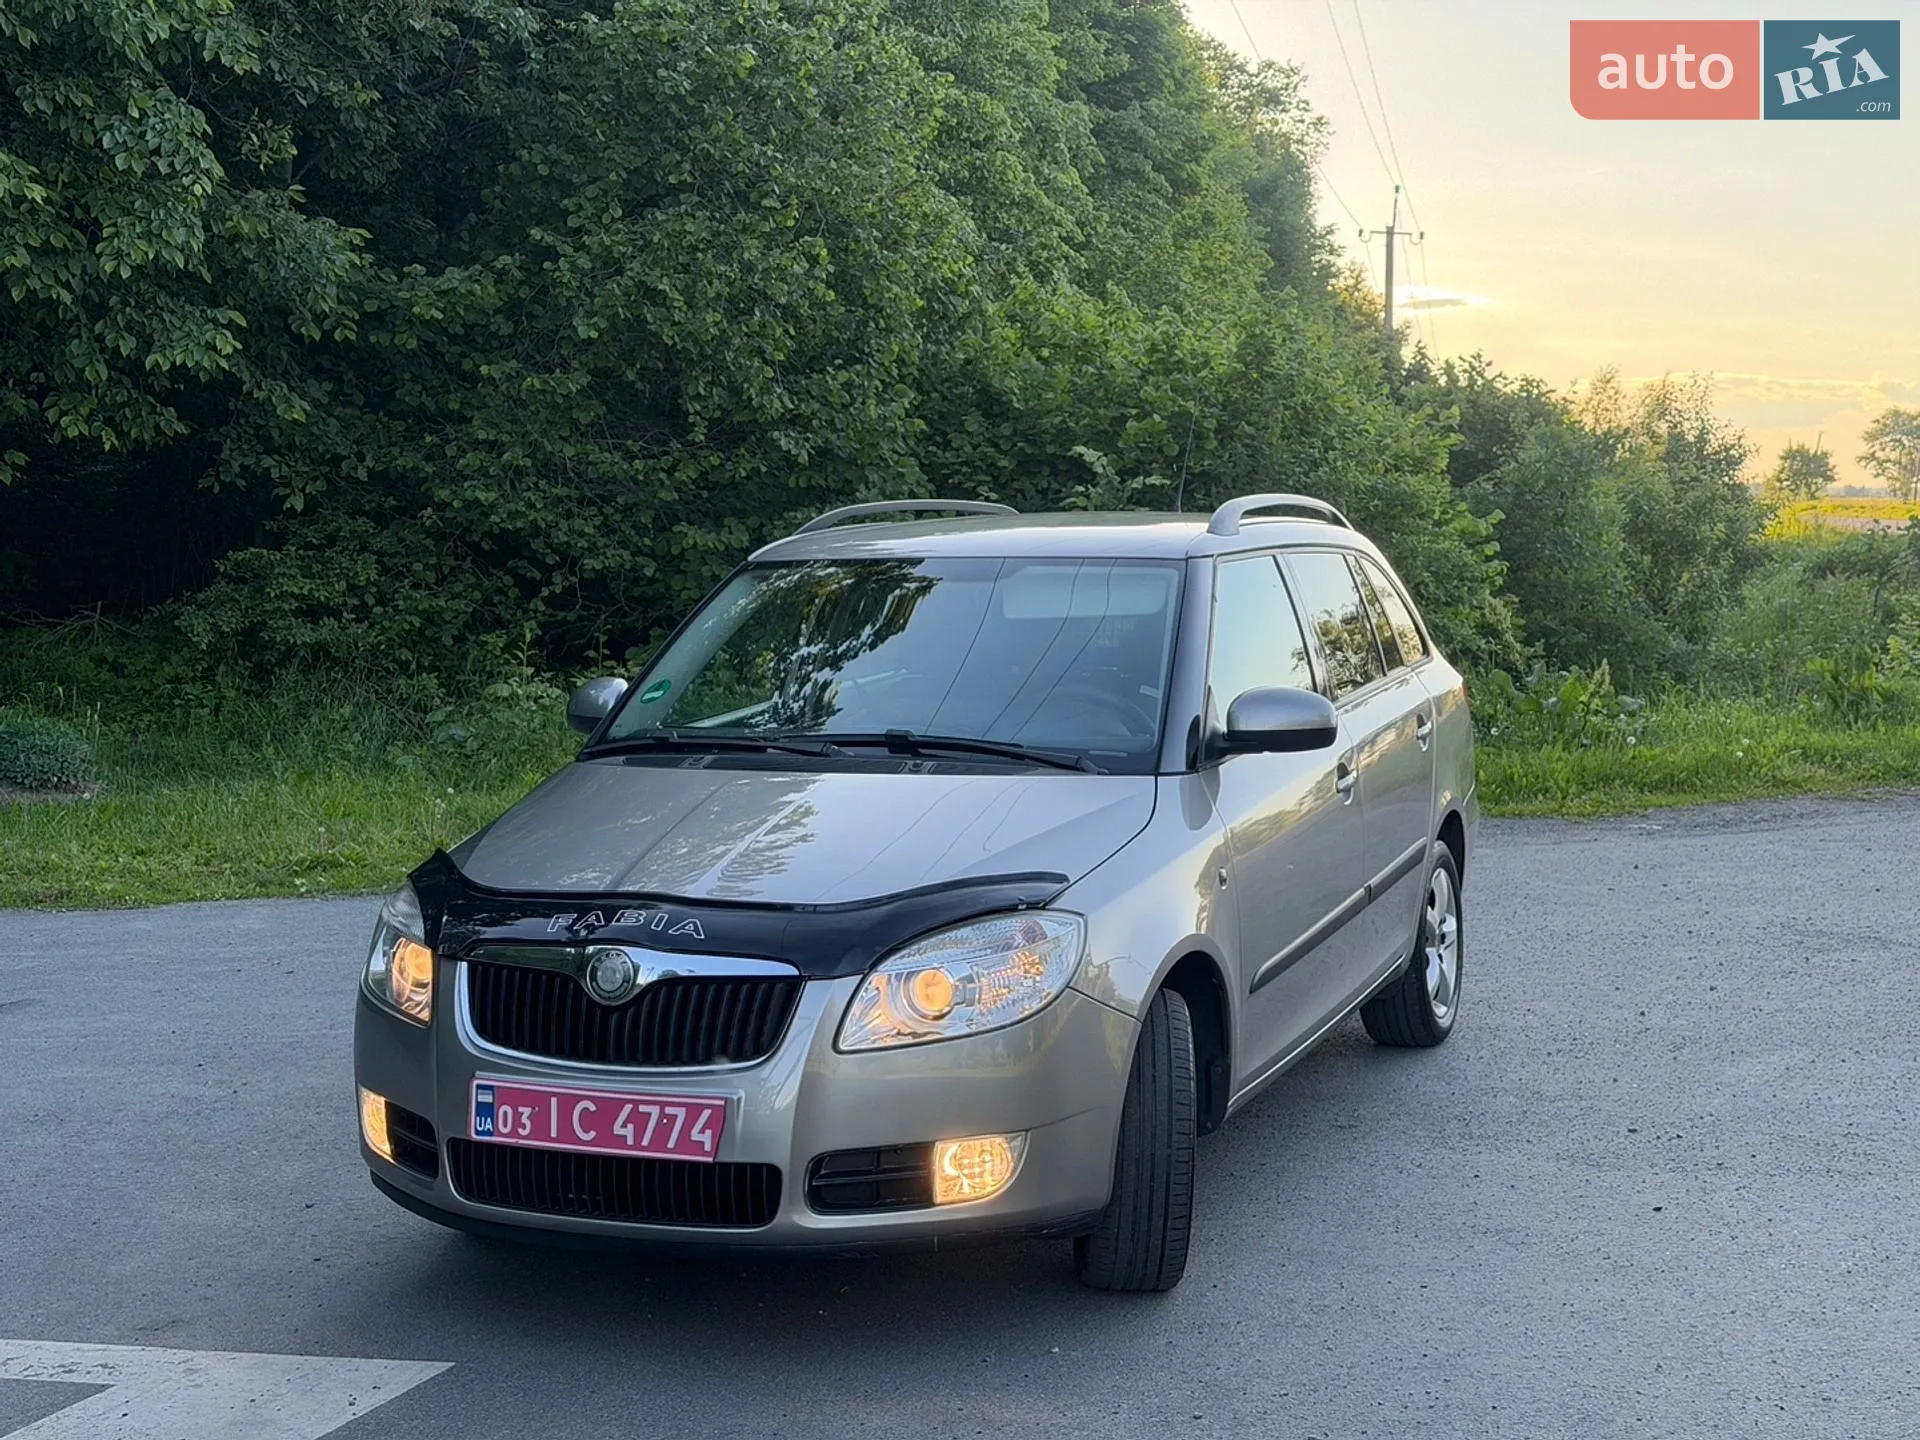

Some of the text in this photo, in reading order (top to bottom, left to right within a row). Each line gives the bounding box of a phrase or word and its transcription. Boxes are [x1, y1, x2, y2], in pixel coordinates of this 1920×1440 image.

[546, 909, 706, 939] FABIA
[476, 1115, 494, 1132] UA
[497, 1103, 532, 1136] 03
[613, 1103, 713, 1152] 4774
